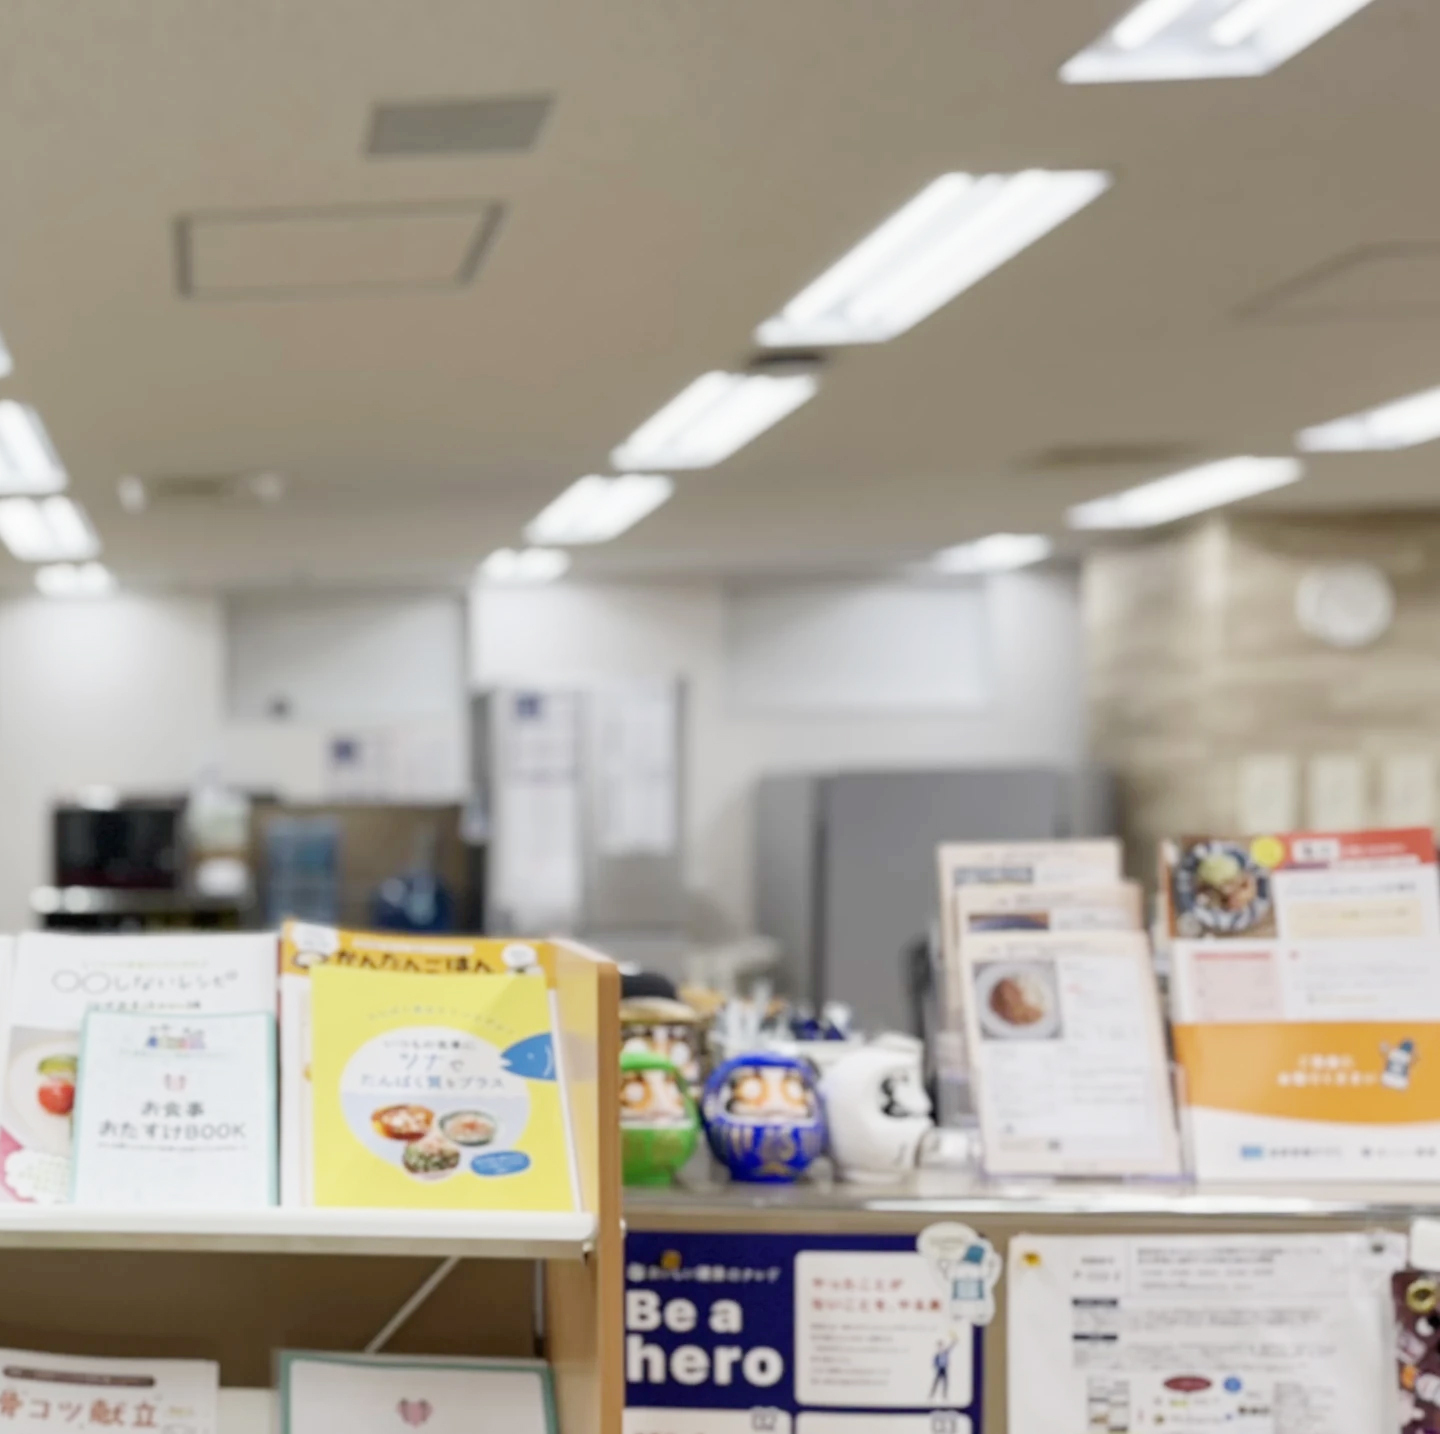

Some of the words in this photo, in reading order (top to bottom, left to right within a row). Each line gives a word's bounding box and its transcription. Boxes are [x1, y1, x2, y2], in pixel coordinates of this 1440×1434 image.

[140, 1100, 205, 1118] お食事
[97, 1119, 248, 1141] おたすけBOOK
[625, 1289, 698, 1332] Be
[708, 1299, 744, 1333] a
[626, 1334, 785, 1387] hero
